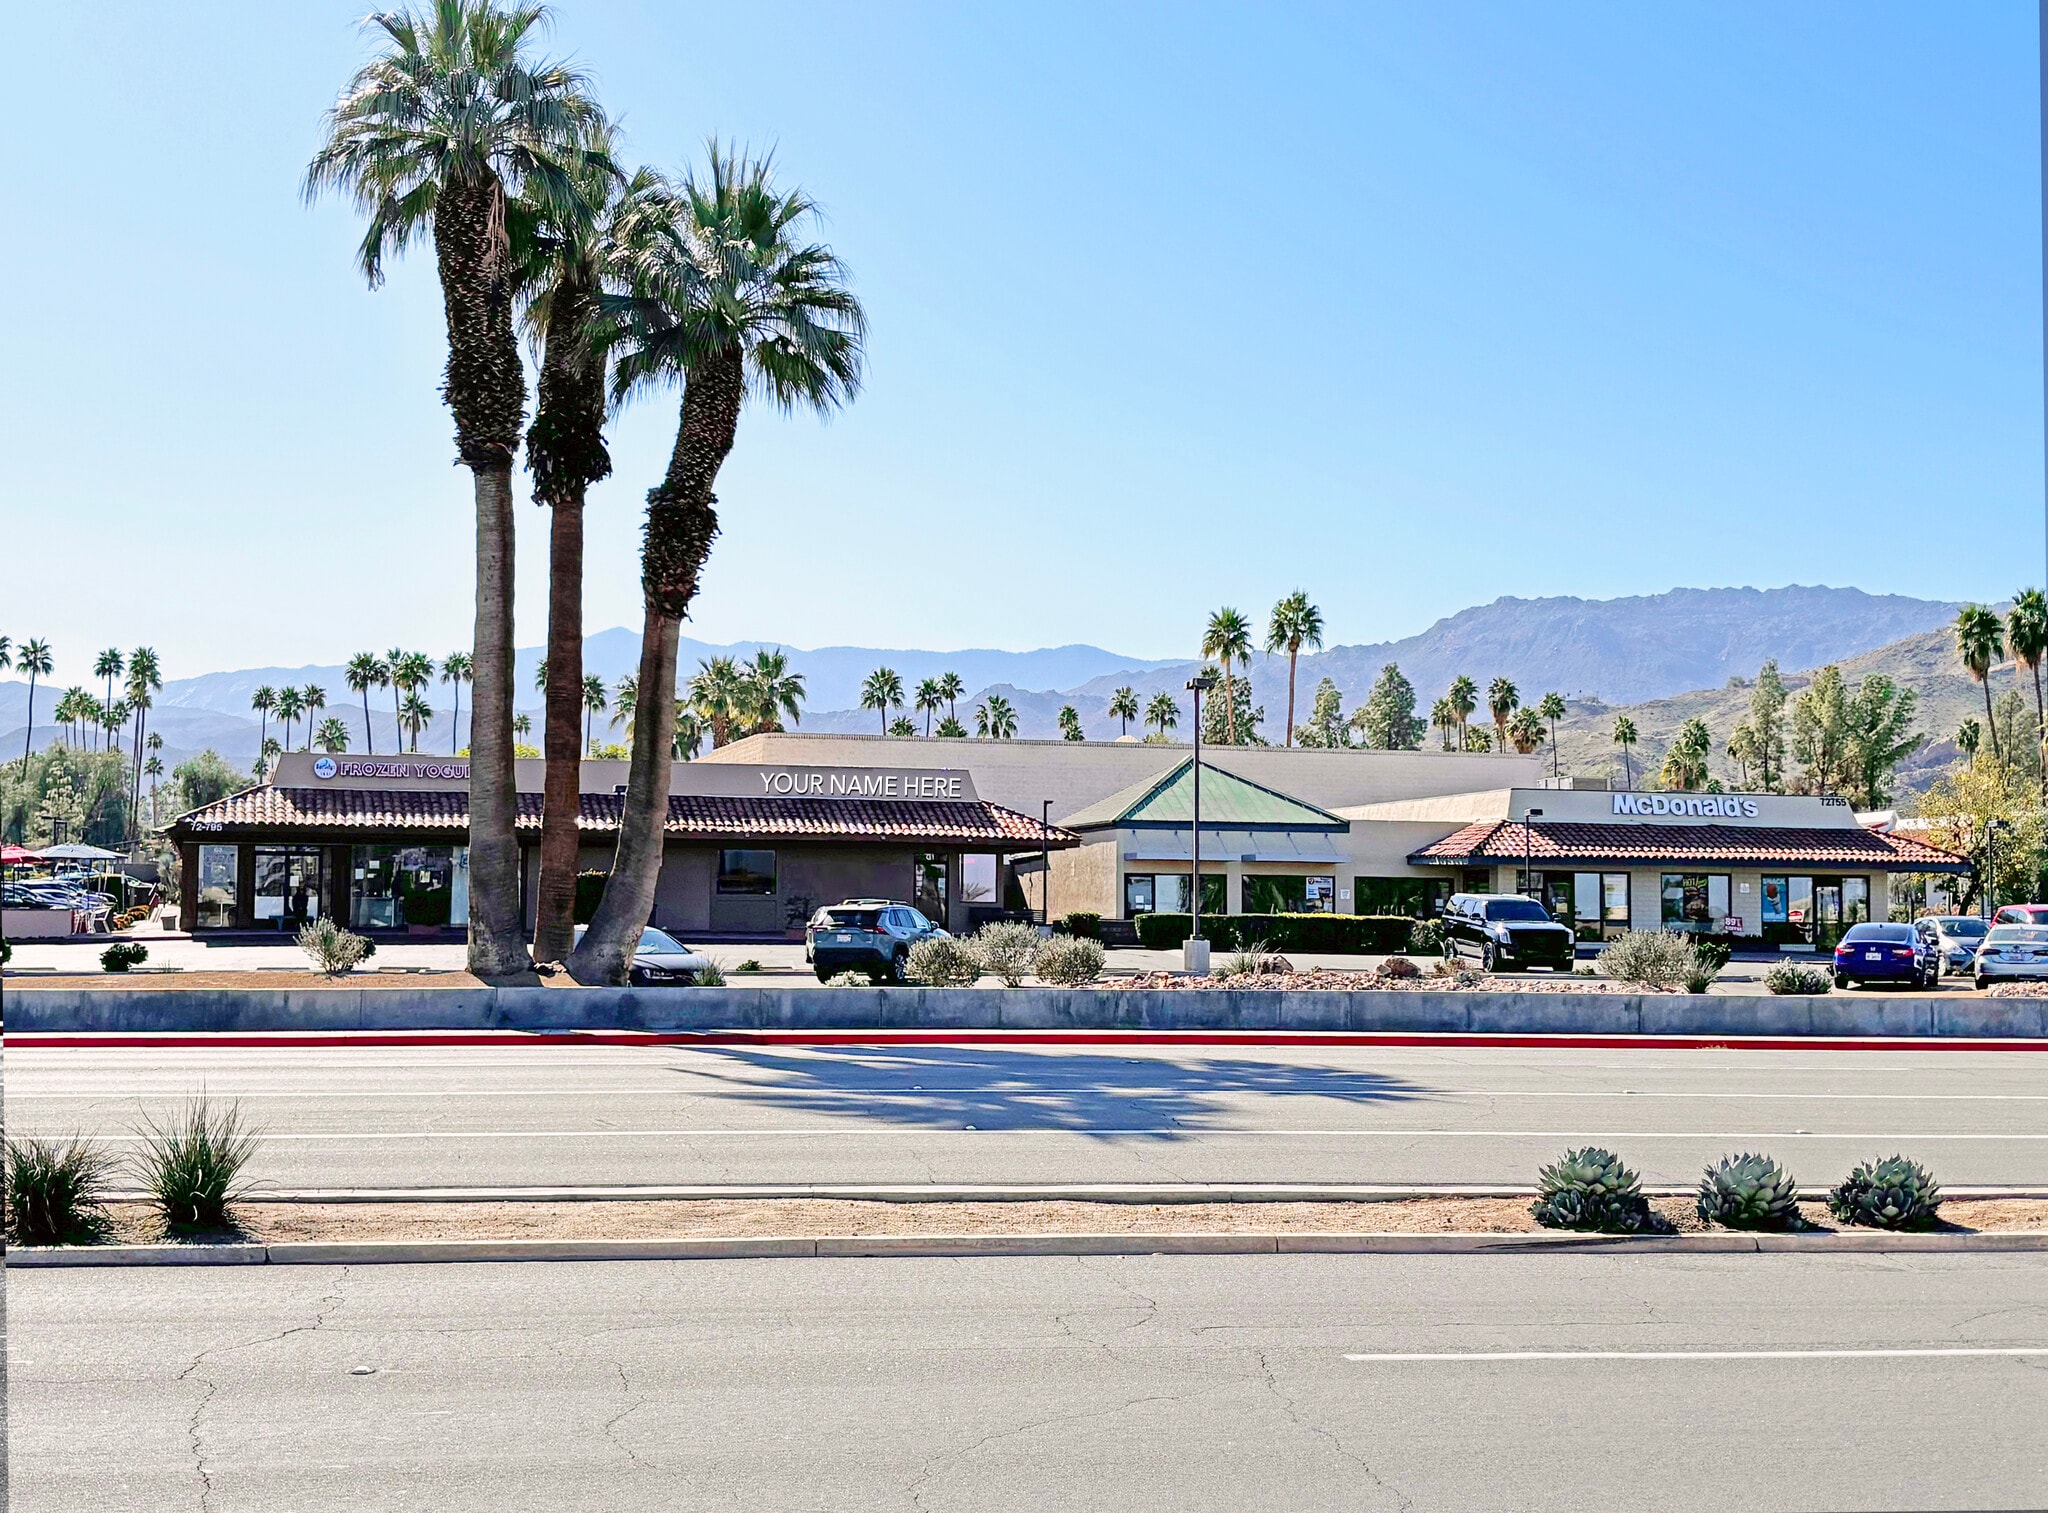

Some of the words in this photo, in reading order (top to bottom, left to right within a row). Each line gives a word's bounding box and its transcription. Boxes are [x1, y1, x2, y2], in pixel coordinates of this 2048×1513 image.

[340, 761, 410, 778] FROZEN
[760, 772, 824, 795] YOUR
[830, 774, 898, 797] NAME
[904, 776, 962, 798] HERE
[1613, 794, 1759, 818] McDonald's
[1820, 797, 1847, 807] 72755
